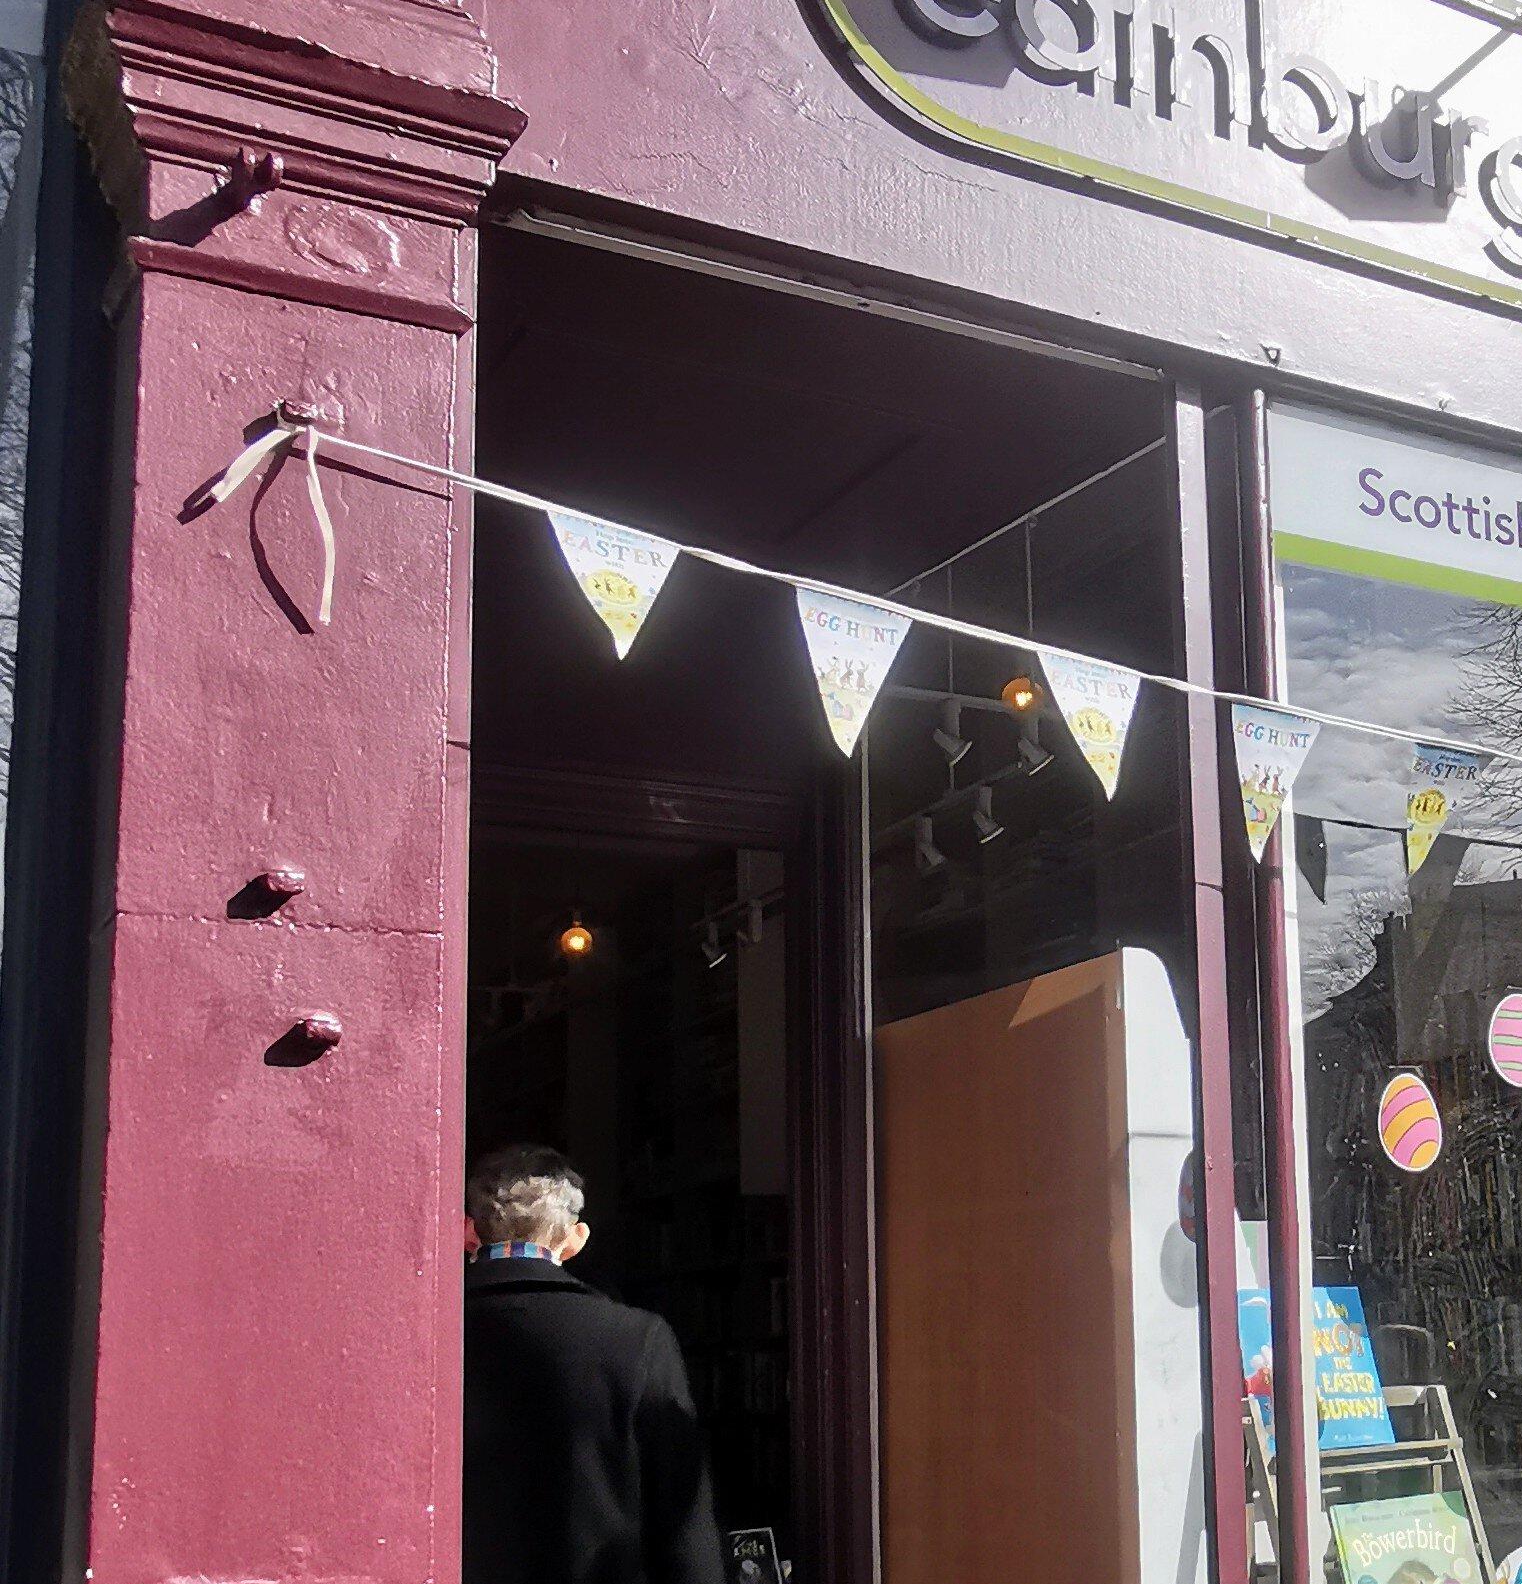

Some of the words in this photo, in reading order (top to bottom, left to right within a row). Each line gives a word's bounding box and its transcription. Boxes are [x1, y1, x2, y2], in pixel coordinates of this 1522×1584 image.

[561, 528, 669, 569] EASTER
[803, 606, 841, 631] EGG
[1049, 670, 1132, 700] EASTER
[1235, 721, 1265, 741] EGG
[1267, 727, 1310, 748] HUNT
[1412, 756, 1477, 781] EASTER
[1312, 1323, 1366, 1358] NOT
[1352, 1517, 1457, 1568] Bowerbird
